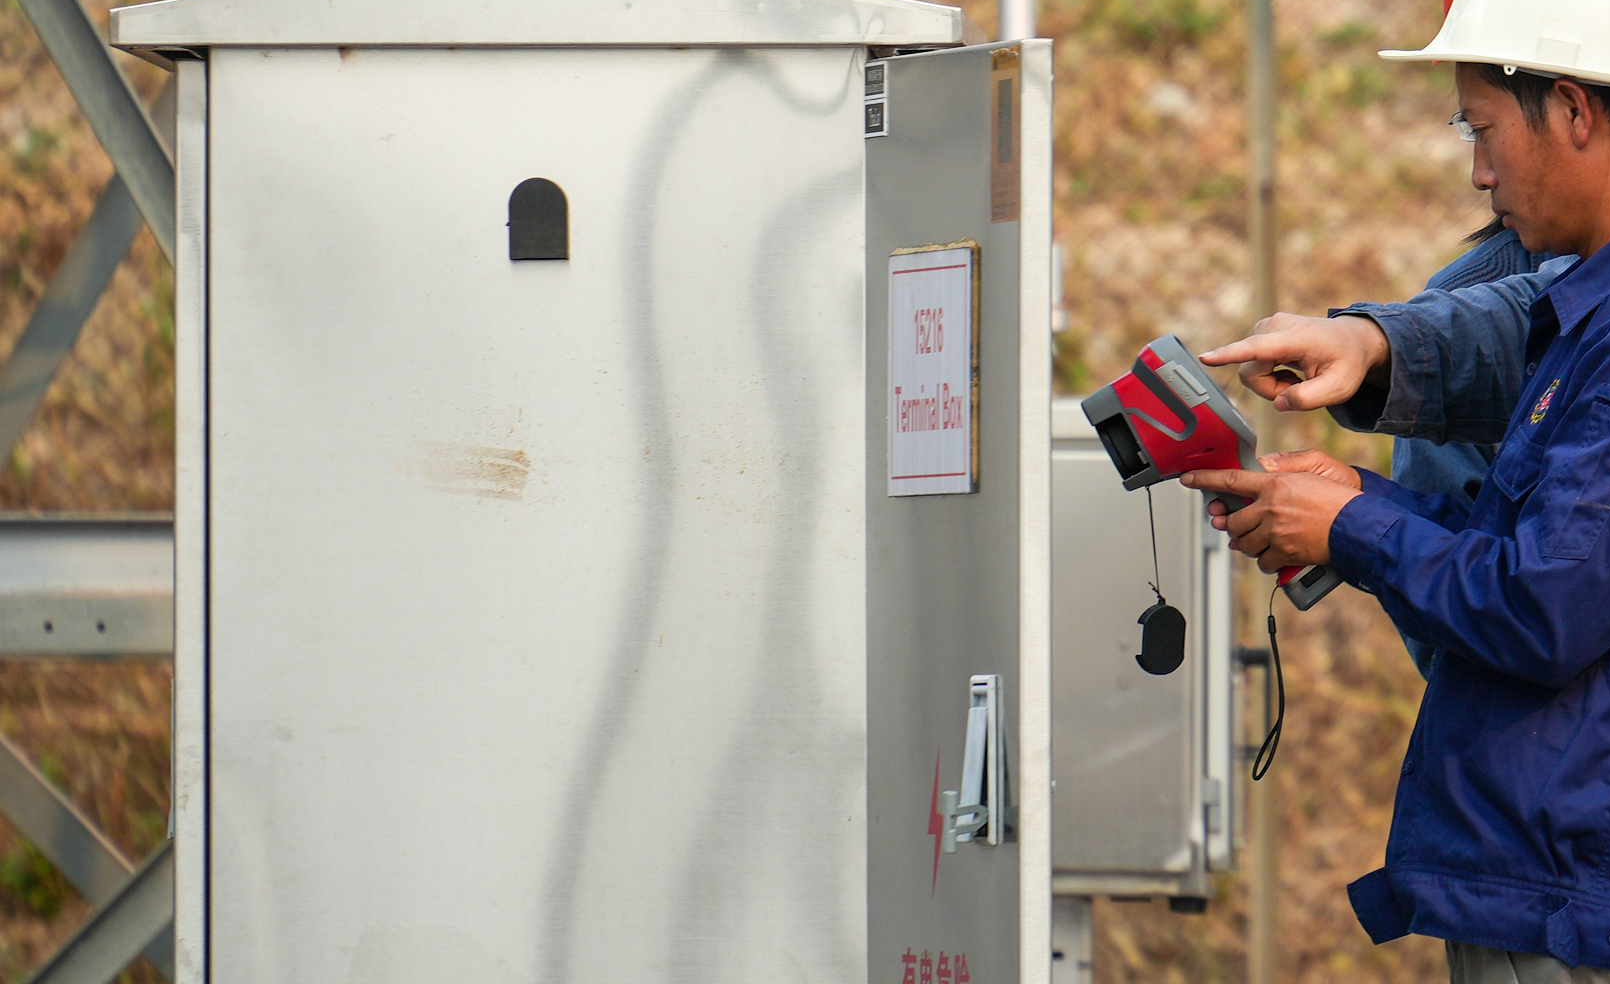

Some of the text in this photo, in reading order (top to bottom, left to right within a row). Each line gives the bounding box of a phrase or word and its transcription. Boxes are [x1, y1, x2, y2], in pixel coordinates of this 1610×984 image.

[914, 307, 945, 355] 15216
[894, 382, 964, 434] Terminal Box
